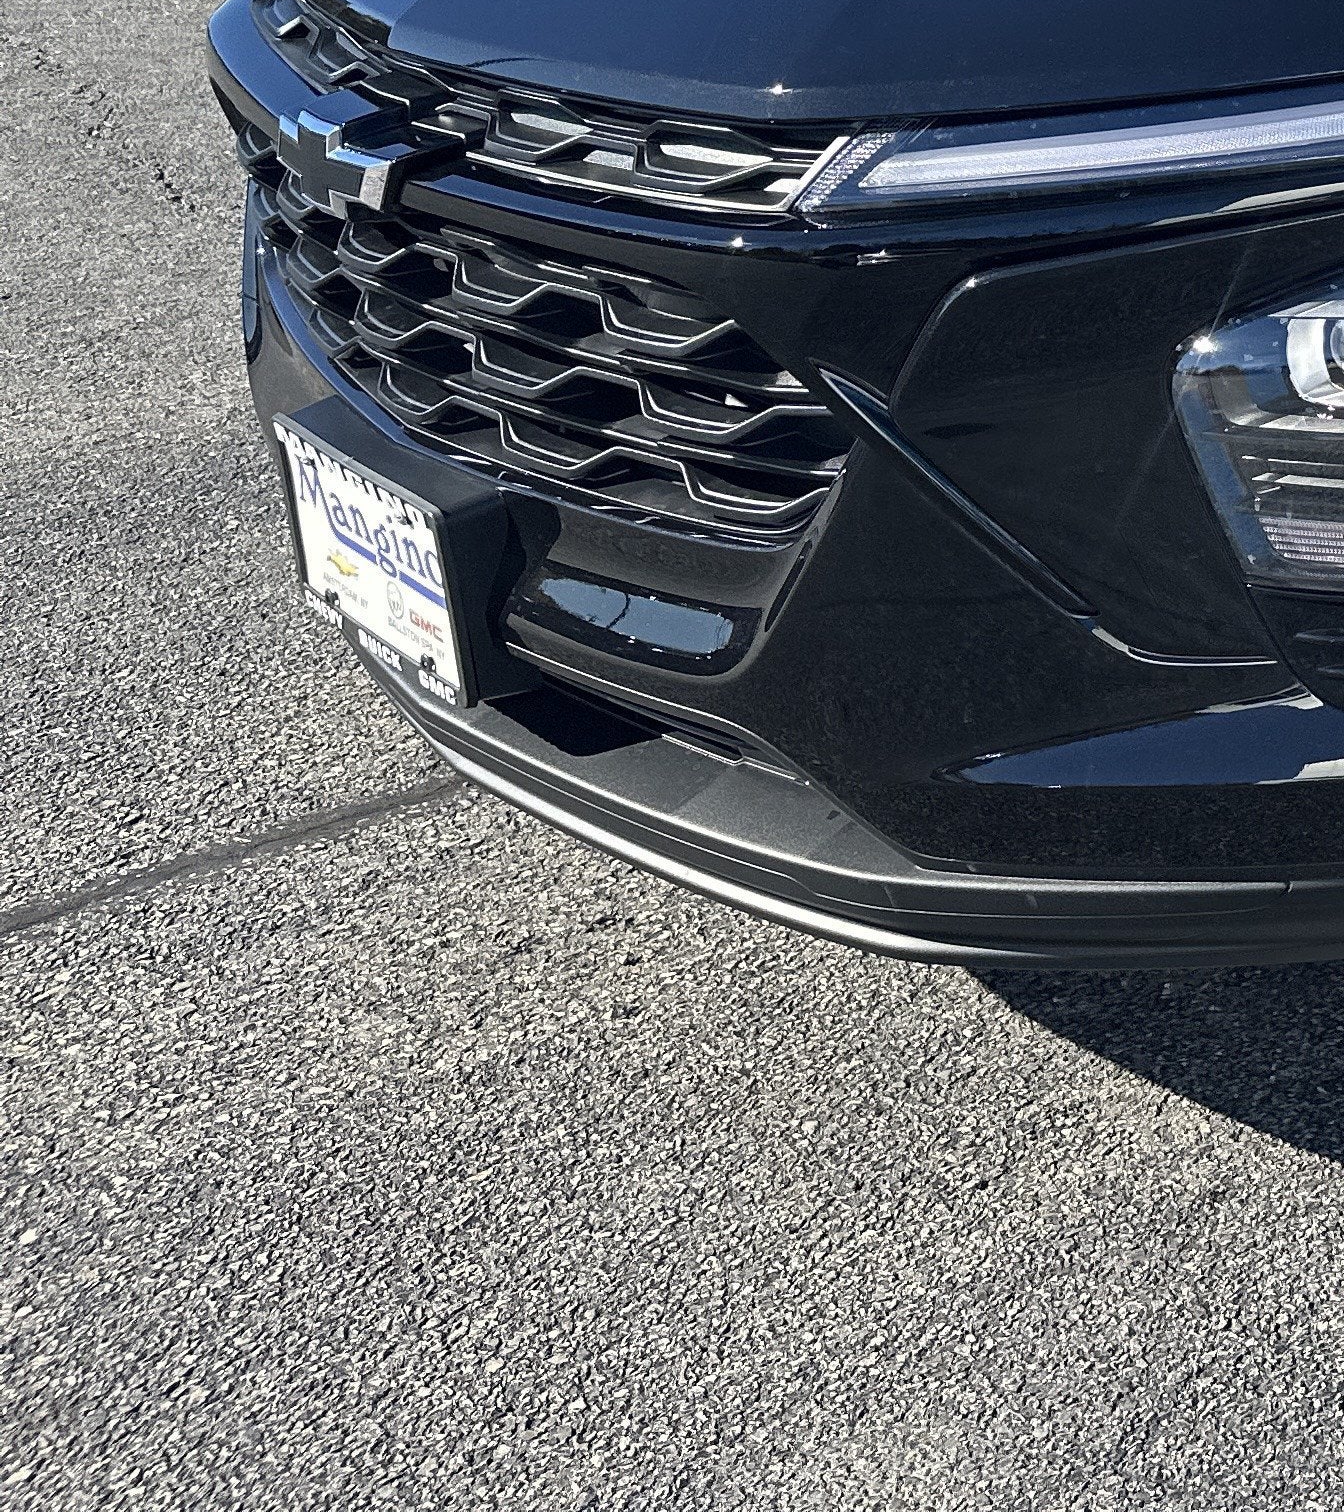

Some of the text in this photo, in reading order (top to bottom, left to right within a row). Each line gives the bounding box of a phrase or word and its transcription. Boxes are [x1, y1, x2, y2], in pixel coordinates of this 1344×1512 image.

[304, 589, 343, 630] CHEVY
[408, 607, 445, 644] GMC
[358, 628, 403, 672] BUICK
[418, 669, 457, 706] GMC
